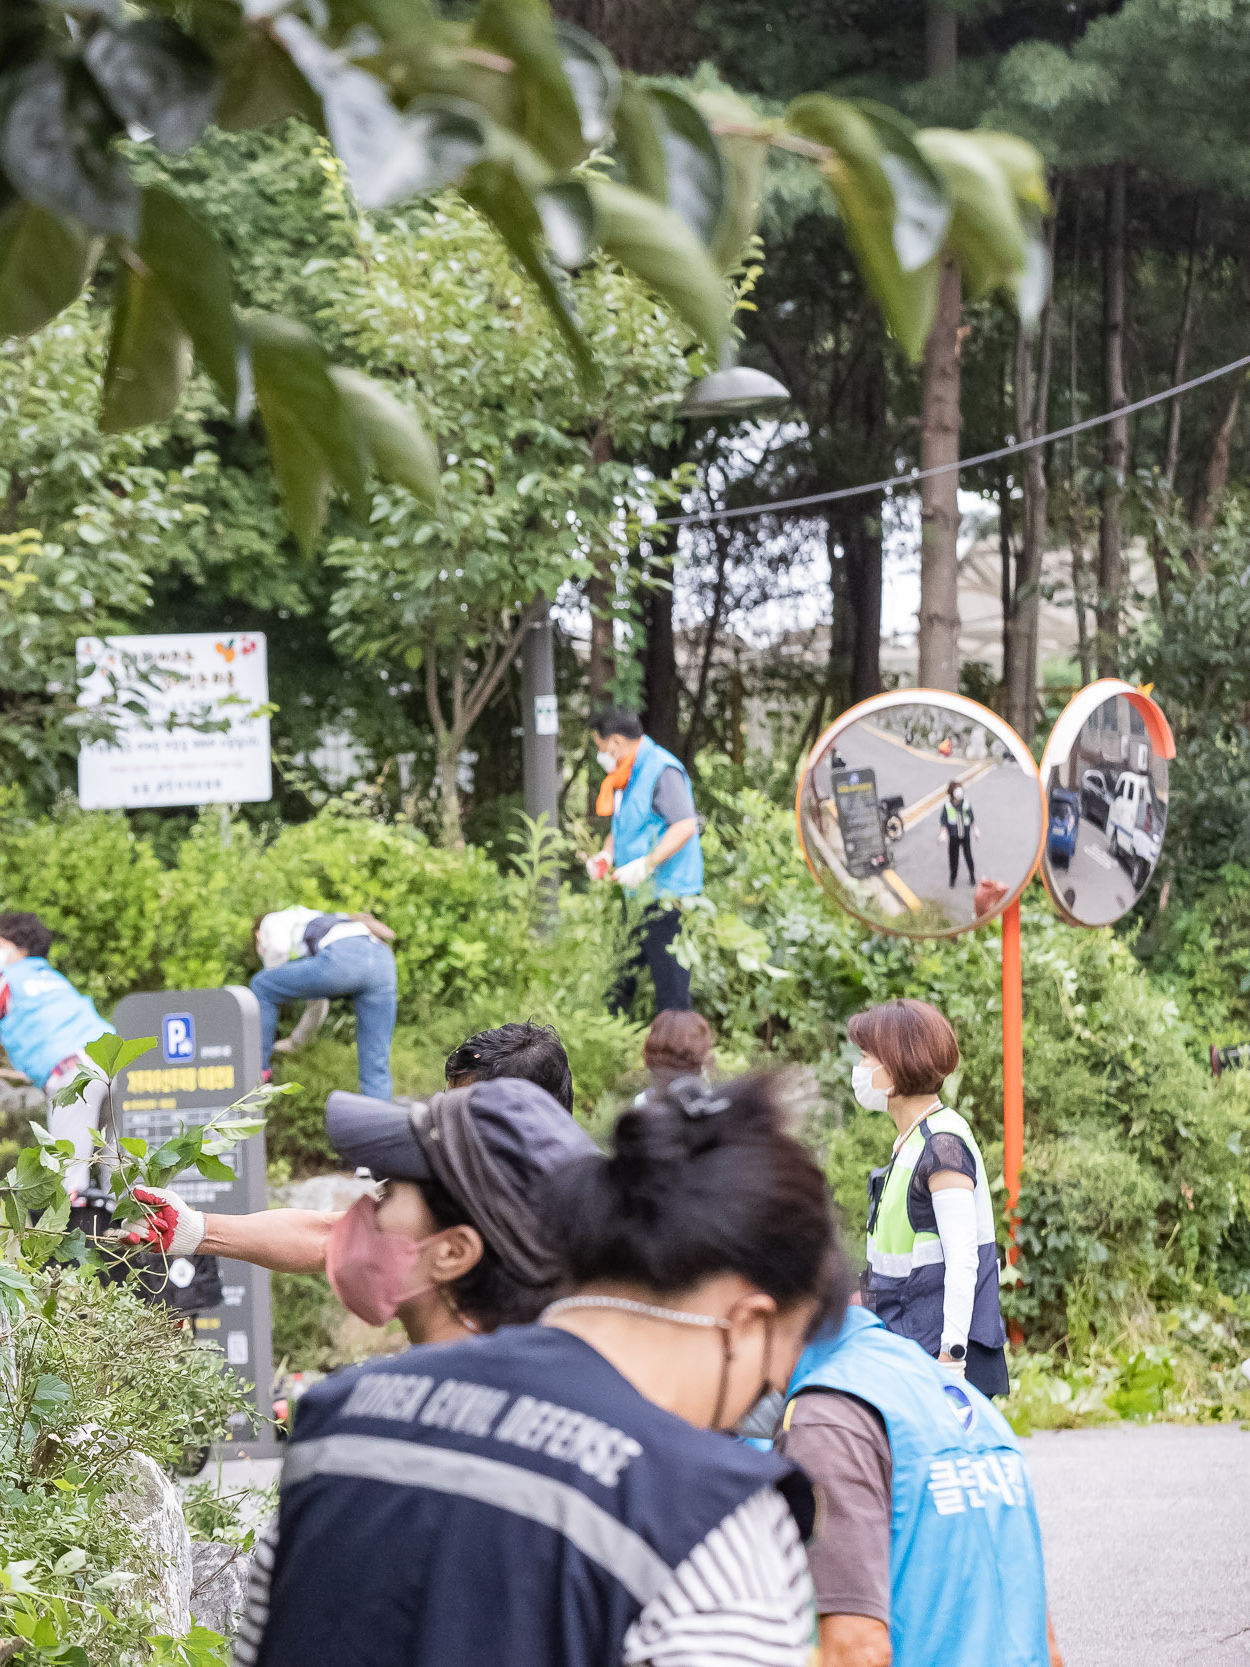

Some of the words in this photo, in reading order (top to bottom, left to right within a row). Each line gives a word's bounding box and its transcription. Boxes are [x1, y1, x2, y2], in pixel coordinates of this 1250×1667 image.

[168, 1019, 187, 1055] P
[420, 1379, 510, 1438] CIVIL
[494, 1395, 644, 1488] DEFENSE
